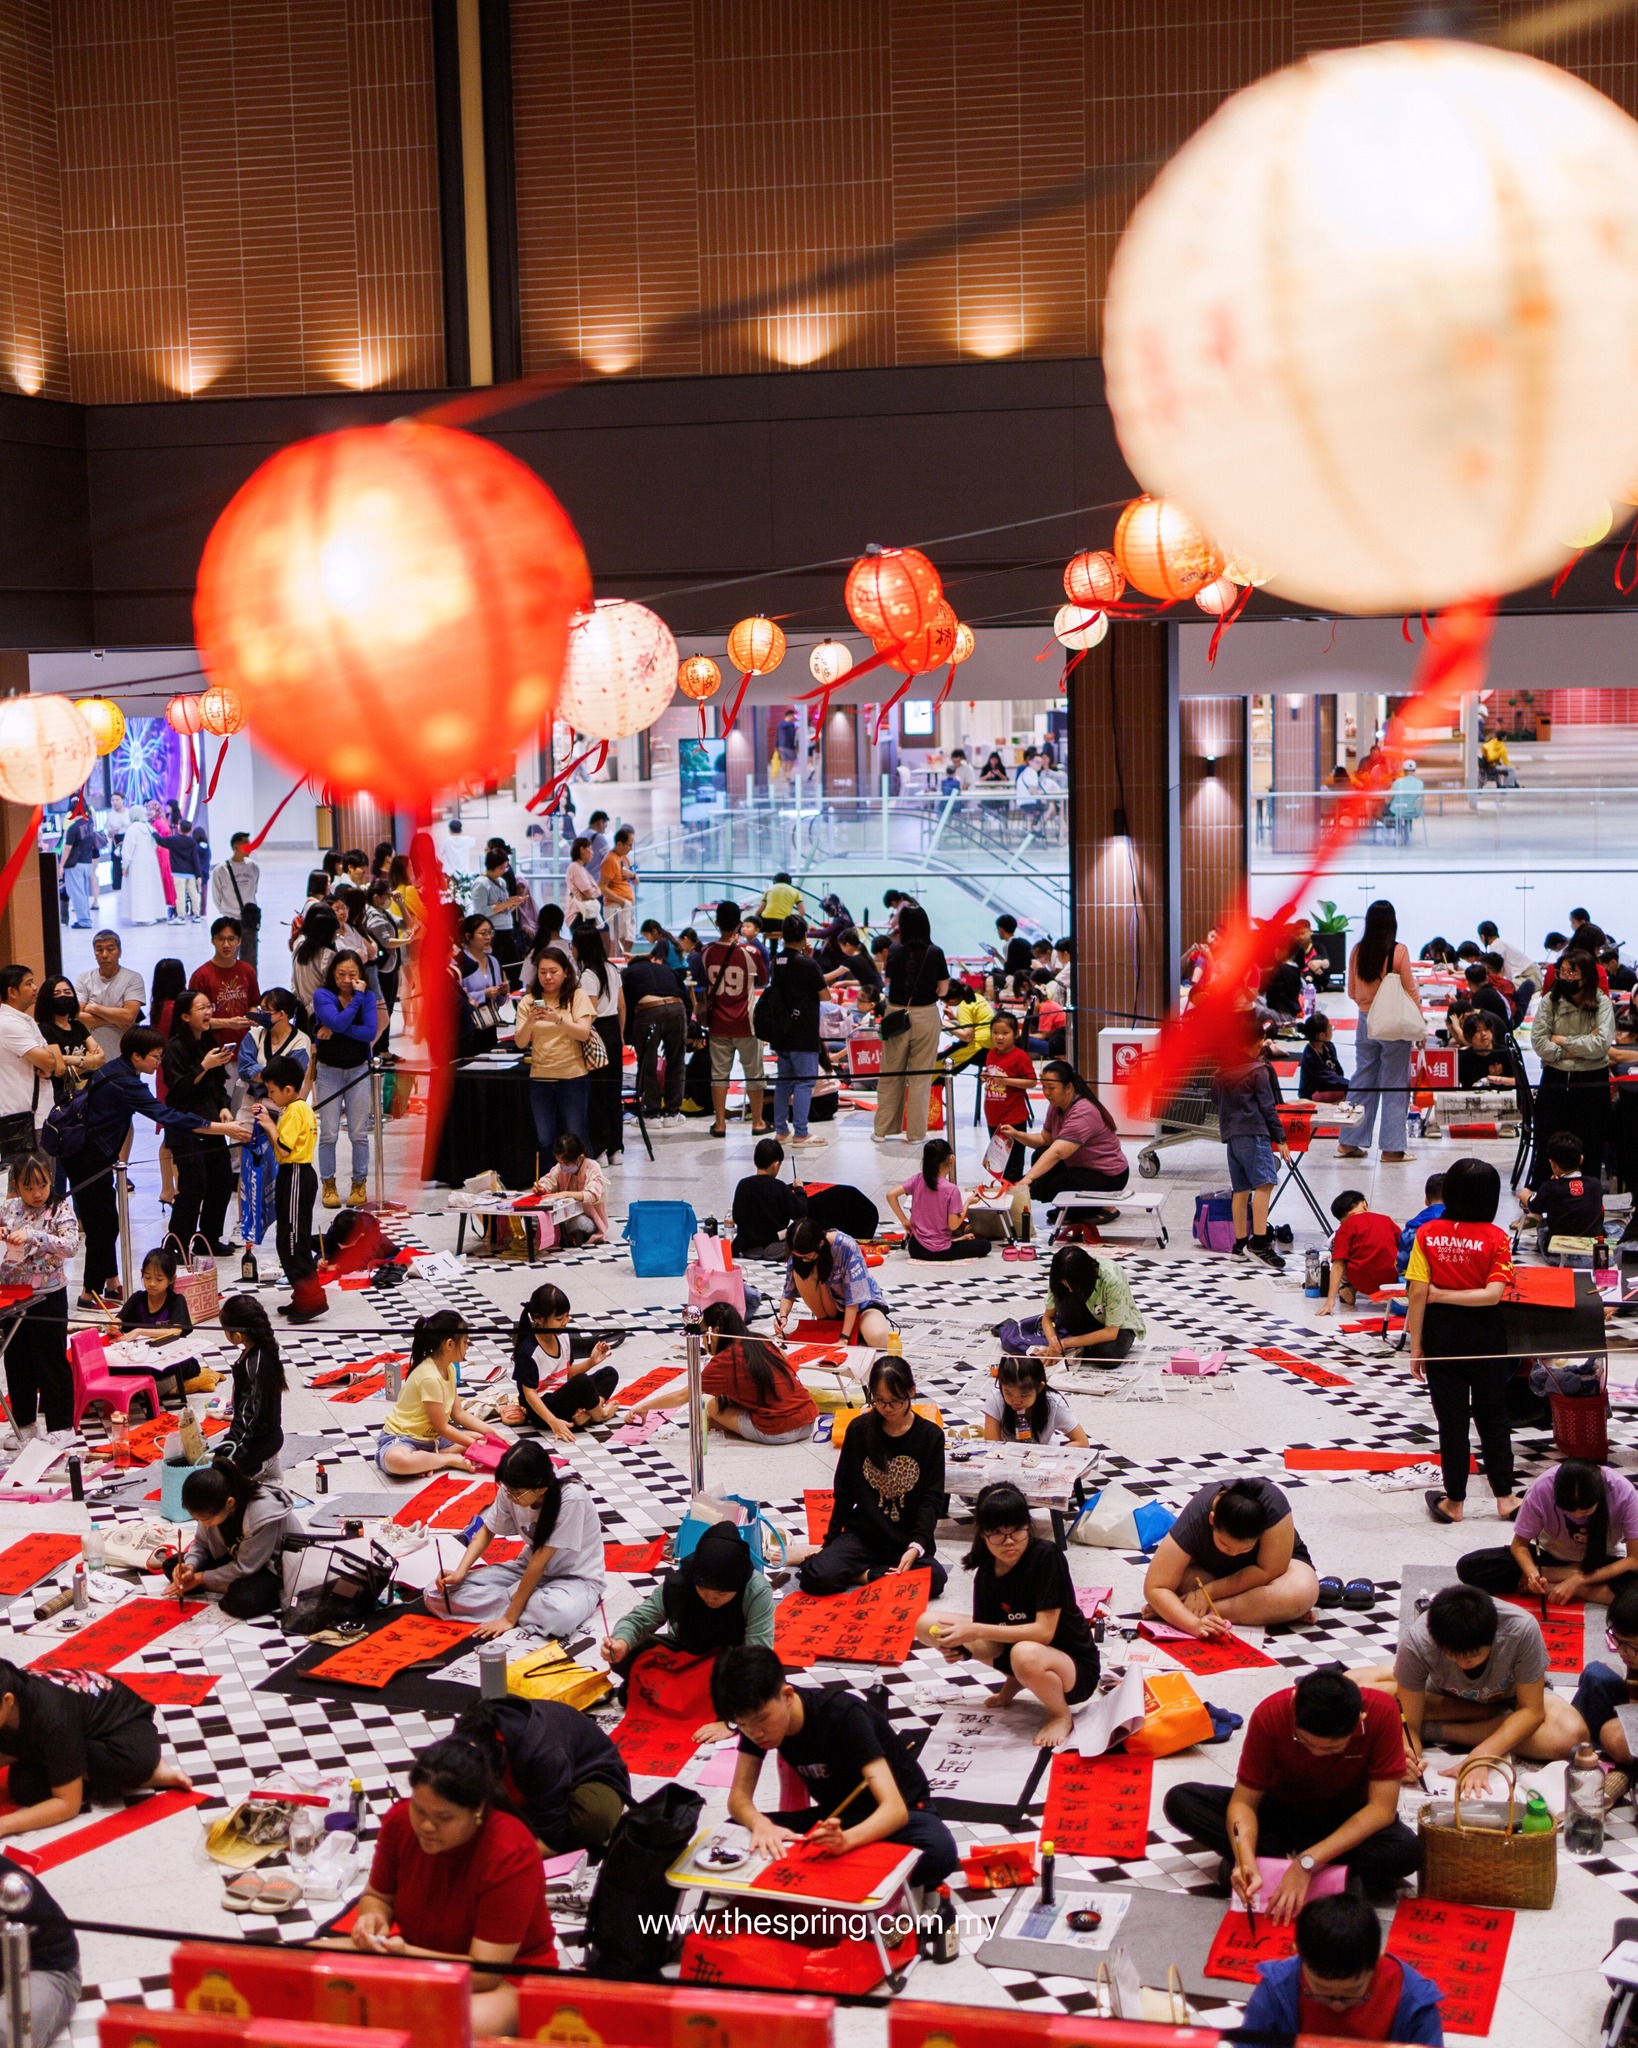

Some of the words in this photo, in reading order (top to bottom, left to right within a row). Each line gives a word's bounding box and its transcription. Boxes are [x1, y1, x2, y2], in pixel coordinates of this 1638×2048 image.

[707, 964, 745, 997] 99
[856, 1050, 882, 1066] 高小
[1426, 1236, 1484, 1252] SARAWAK
